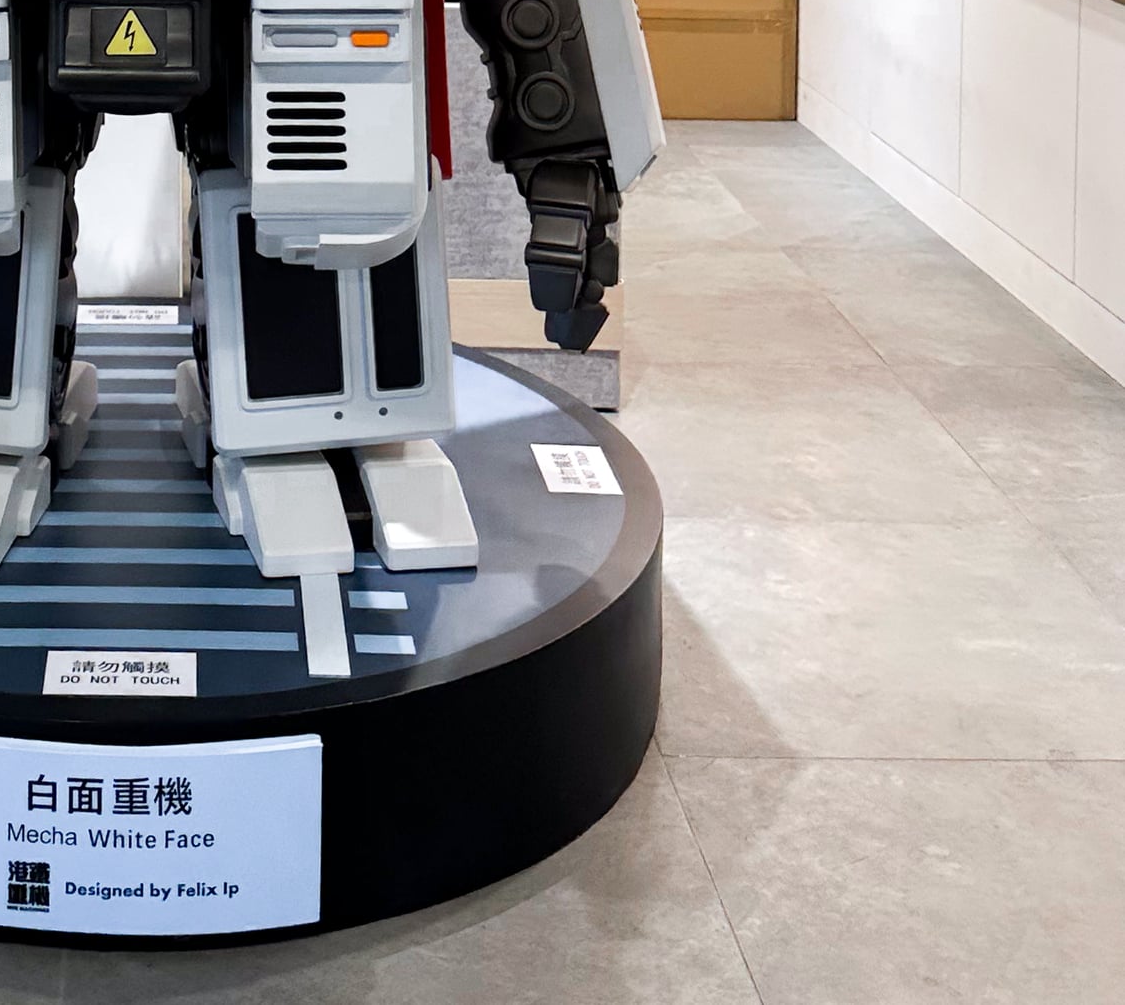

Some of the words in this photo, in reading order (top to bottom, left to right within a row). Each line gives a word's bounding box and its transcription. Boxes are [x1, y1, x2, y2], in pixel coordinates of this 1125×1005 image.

[72, 661, 170, 674] 請勿觸摸
[90, 676, 119, 684] NOT
[131, 676, 180, 685] TOUCH
[28, 774, 193, 816] 白面重機
[7, 823, 77, 846] Mecha
[88, 829, 157, 849] White
[164, 830, 215, 849] Face
[65, 881, 144, 900] Designed
[150, 883, 171, 901] by
[177, 882, 217, 897] Felix
[223, 882, 239, 898] Ip
